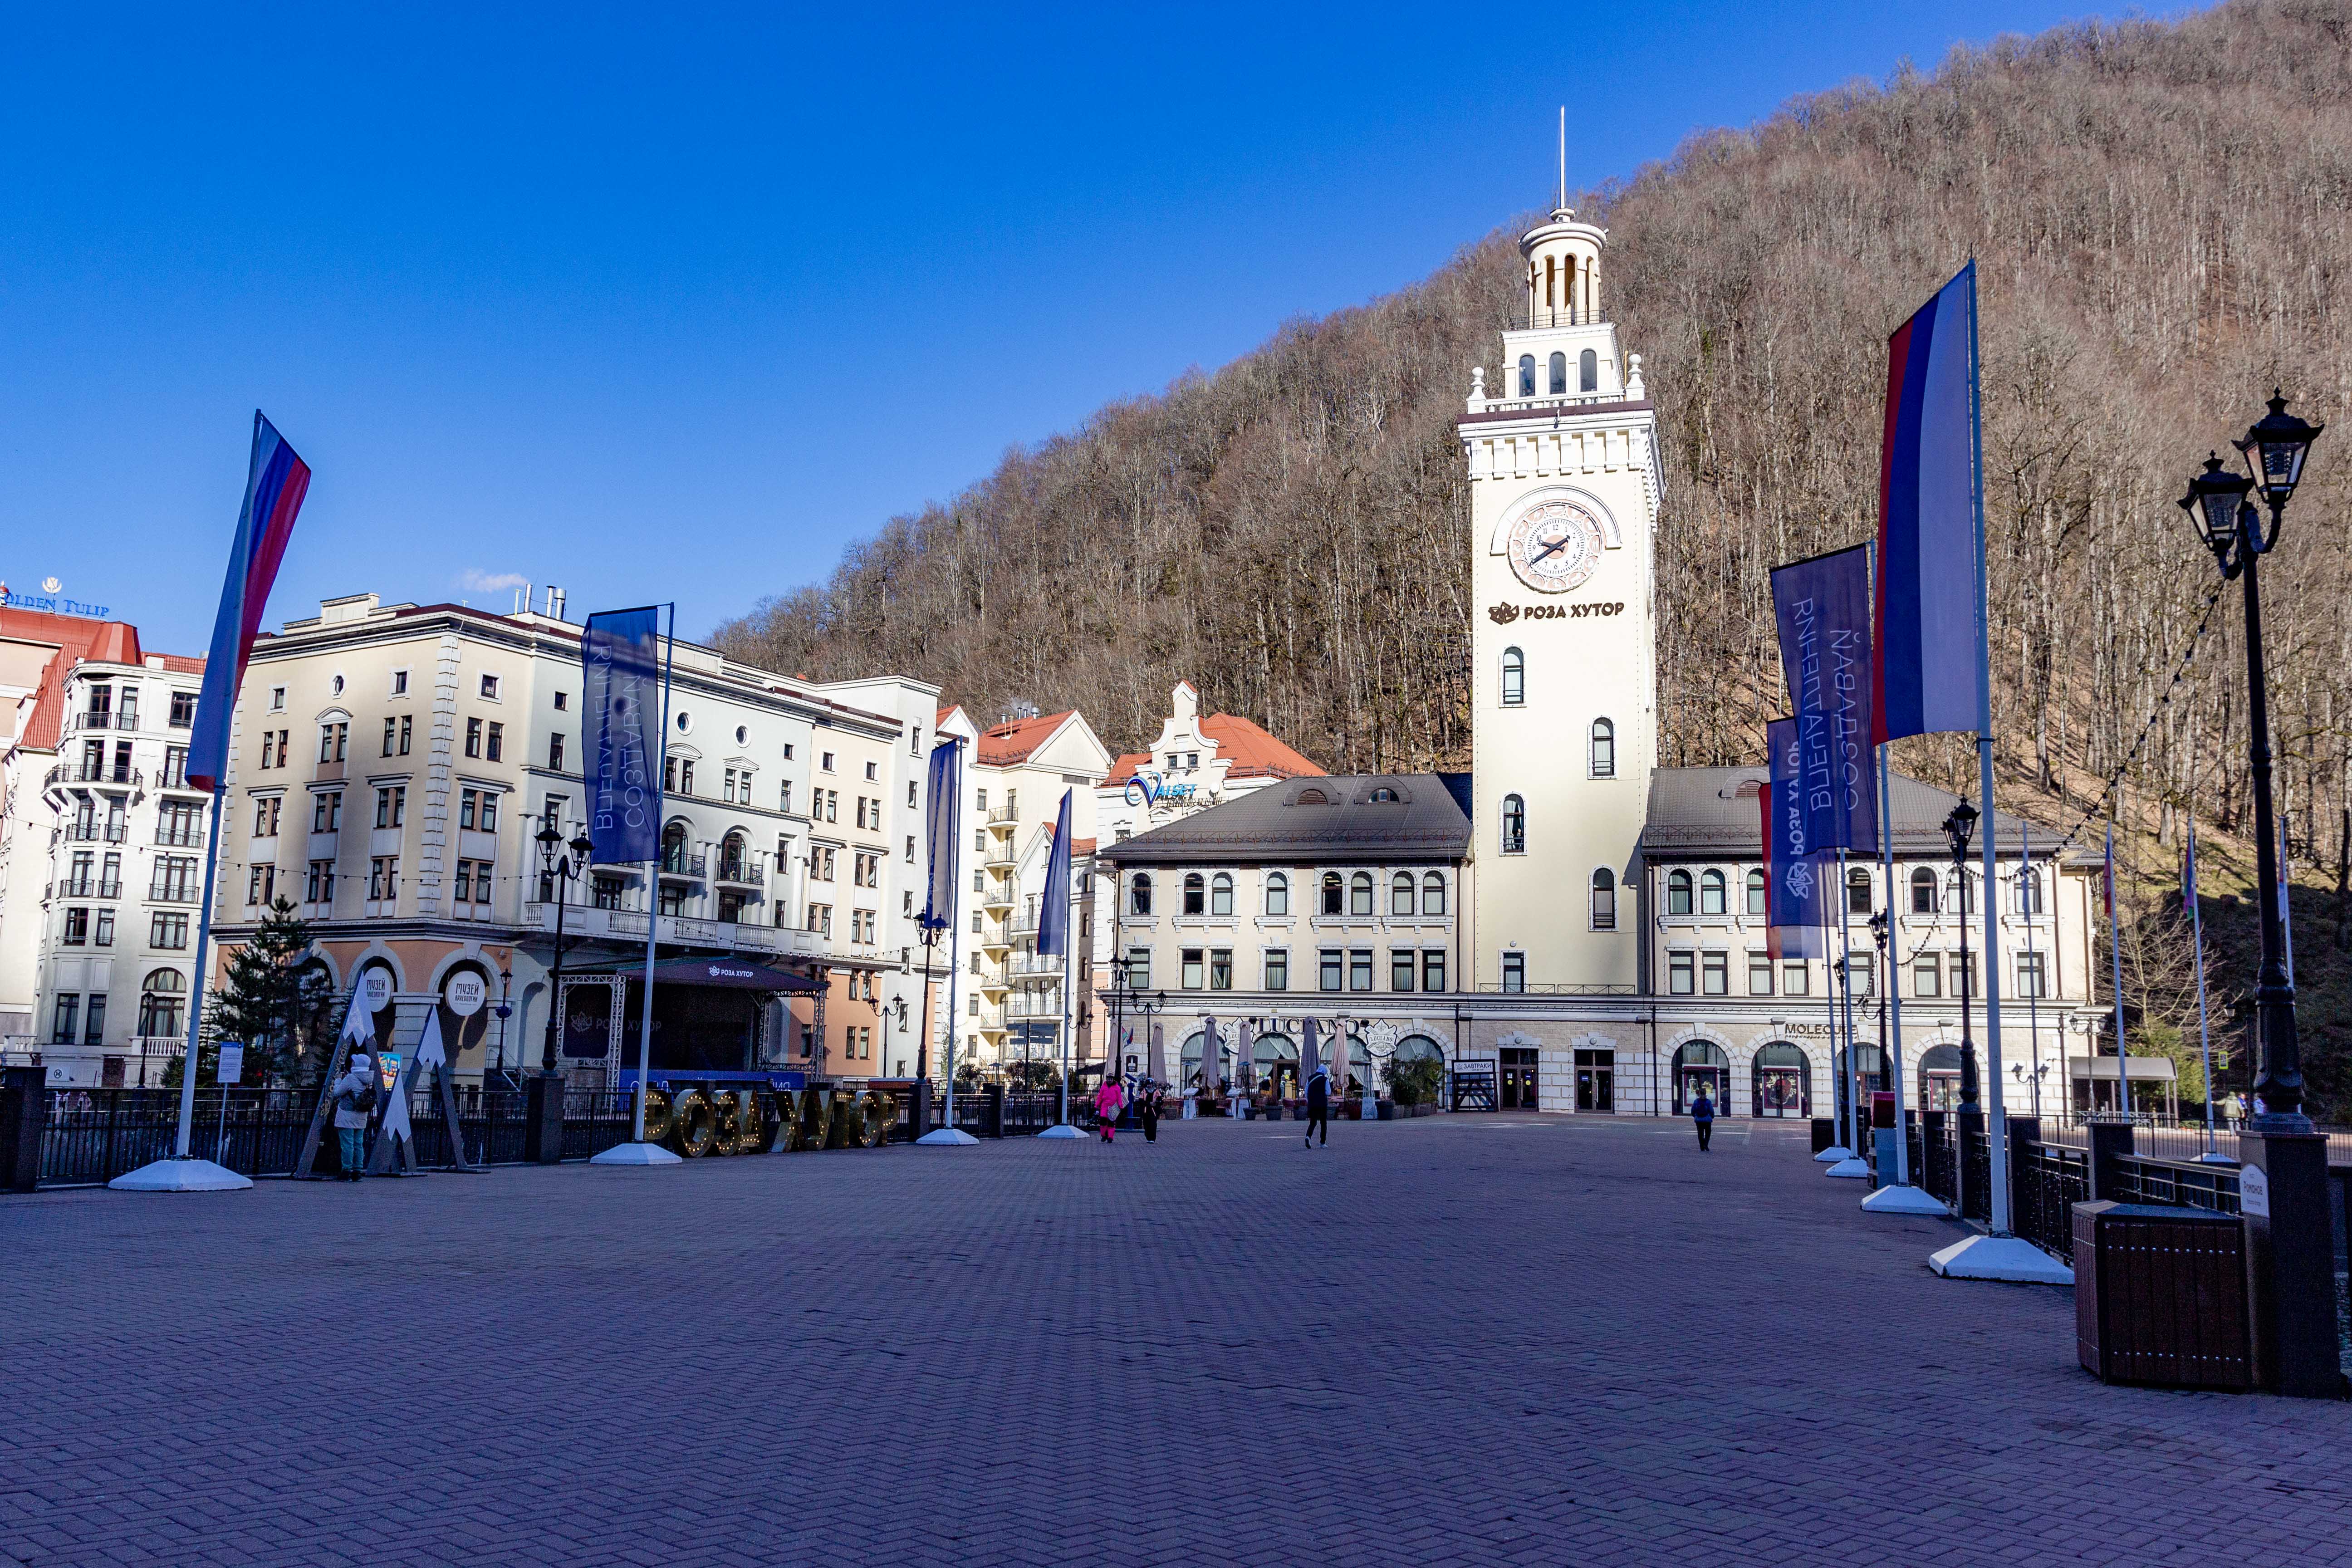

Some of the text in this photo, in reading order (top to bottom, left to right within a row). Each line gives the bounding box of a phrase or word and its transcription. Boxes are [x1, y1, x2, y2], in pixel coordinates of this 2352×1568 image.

[0, 592, 109, 617] OLDEN TULIP
[1524, 603, 1624, 620] РОЗА ХУТОР
[1125, 772, 1198, 805] VALSET
[367, 977, 385, 990] МУЗЕЙ
[456, 982, 479, 995] МУЗЕЙ
[633, 1088, 899, 1157] РОЗА ХУТОР
